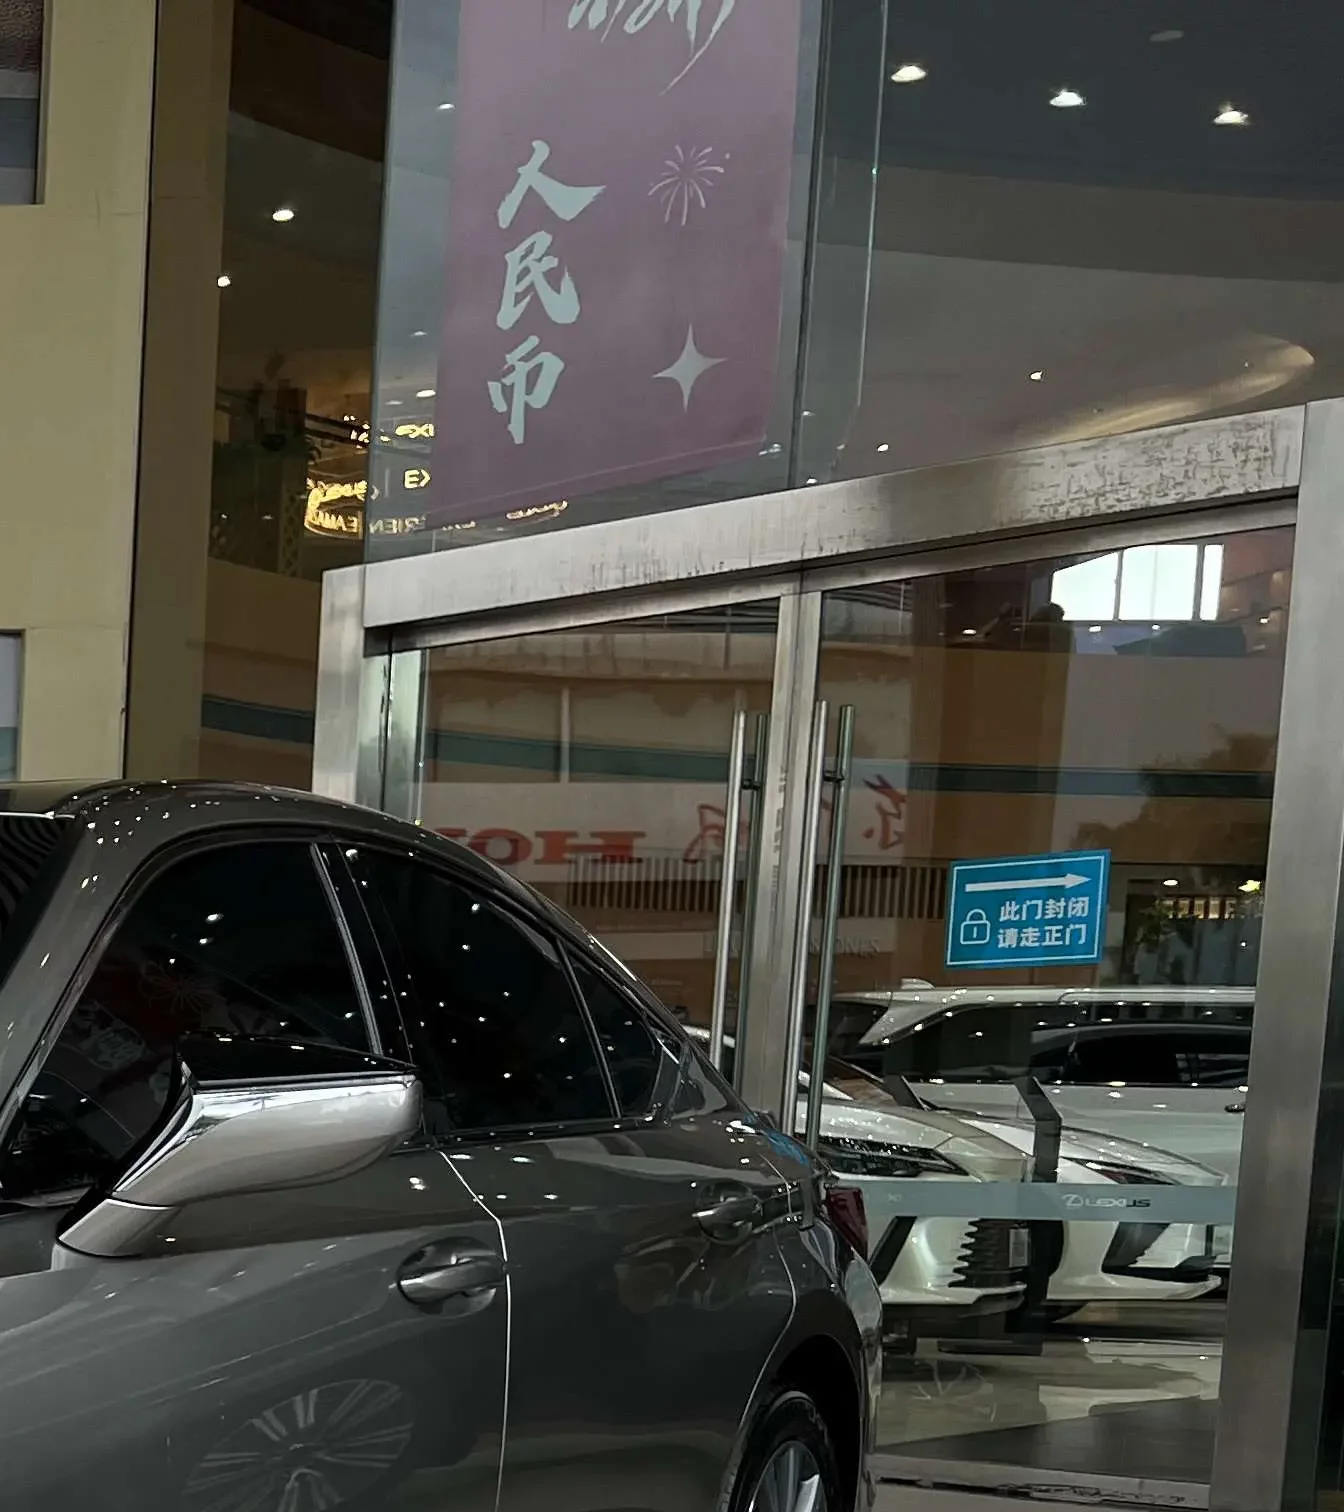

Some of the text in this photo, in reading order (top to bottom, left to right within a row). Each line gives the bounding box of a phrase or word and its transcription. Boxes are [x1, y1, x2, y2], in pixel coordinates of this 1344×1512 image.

[487, 139, 606, 446] 人民币
[999, 896, 1090, 922] 此门封闭
[997, 923, 1087, 949] 请走正门
